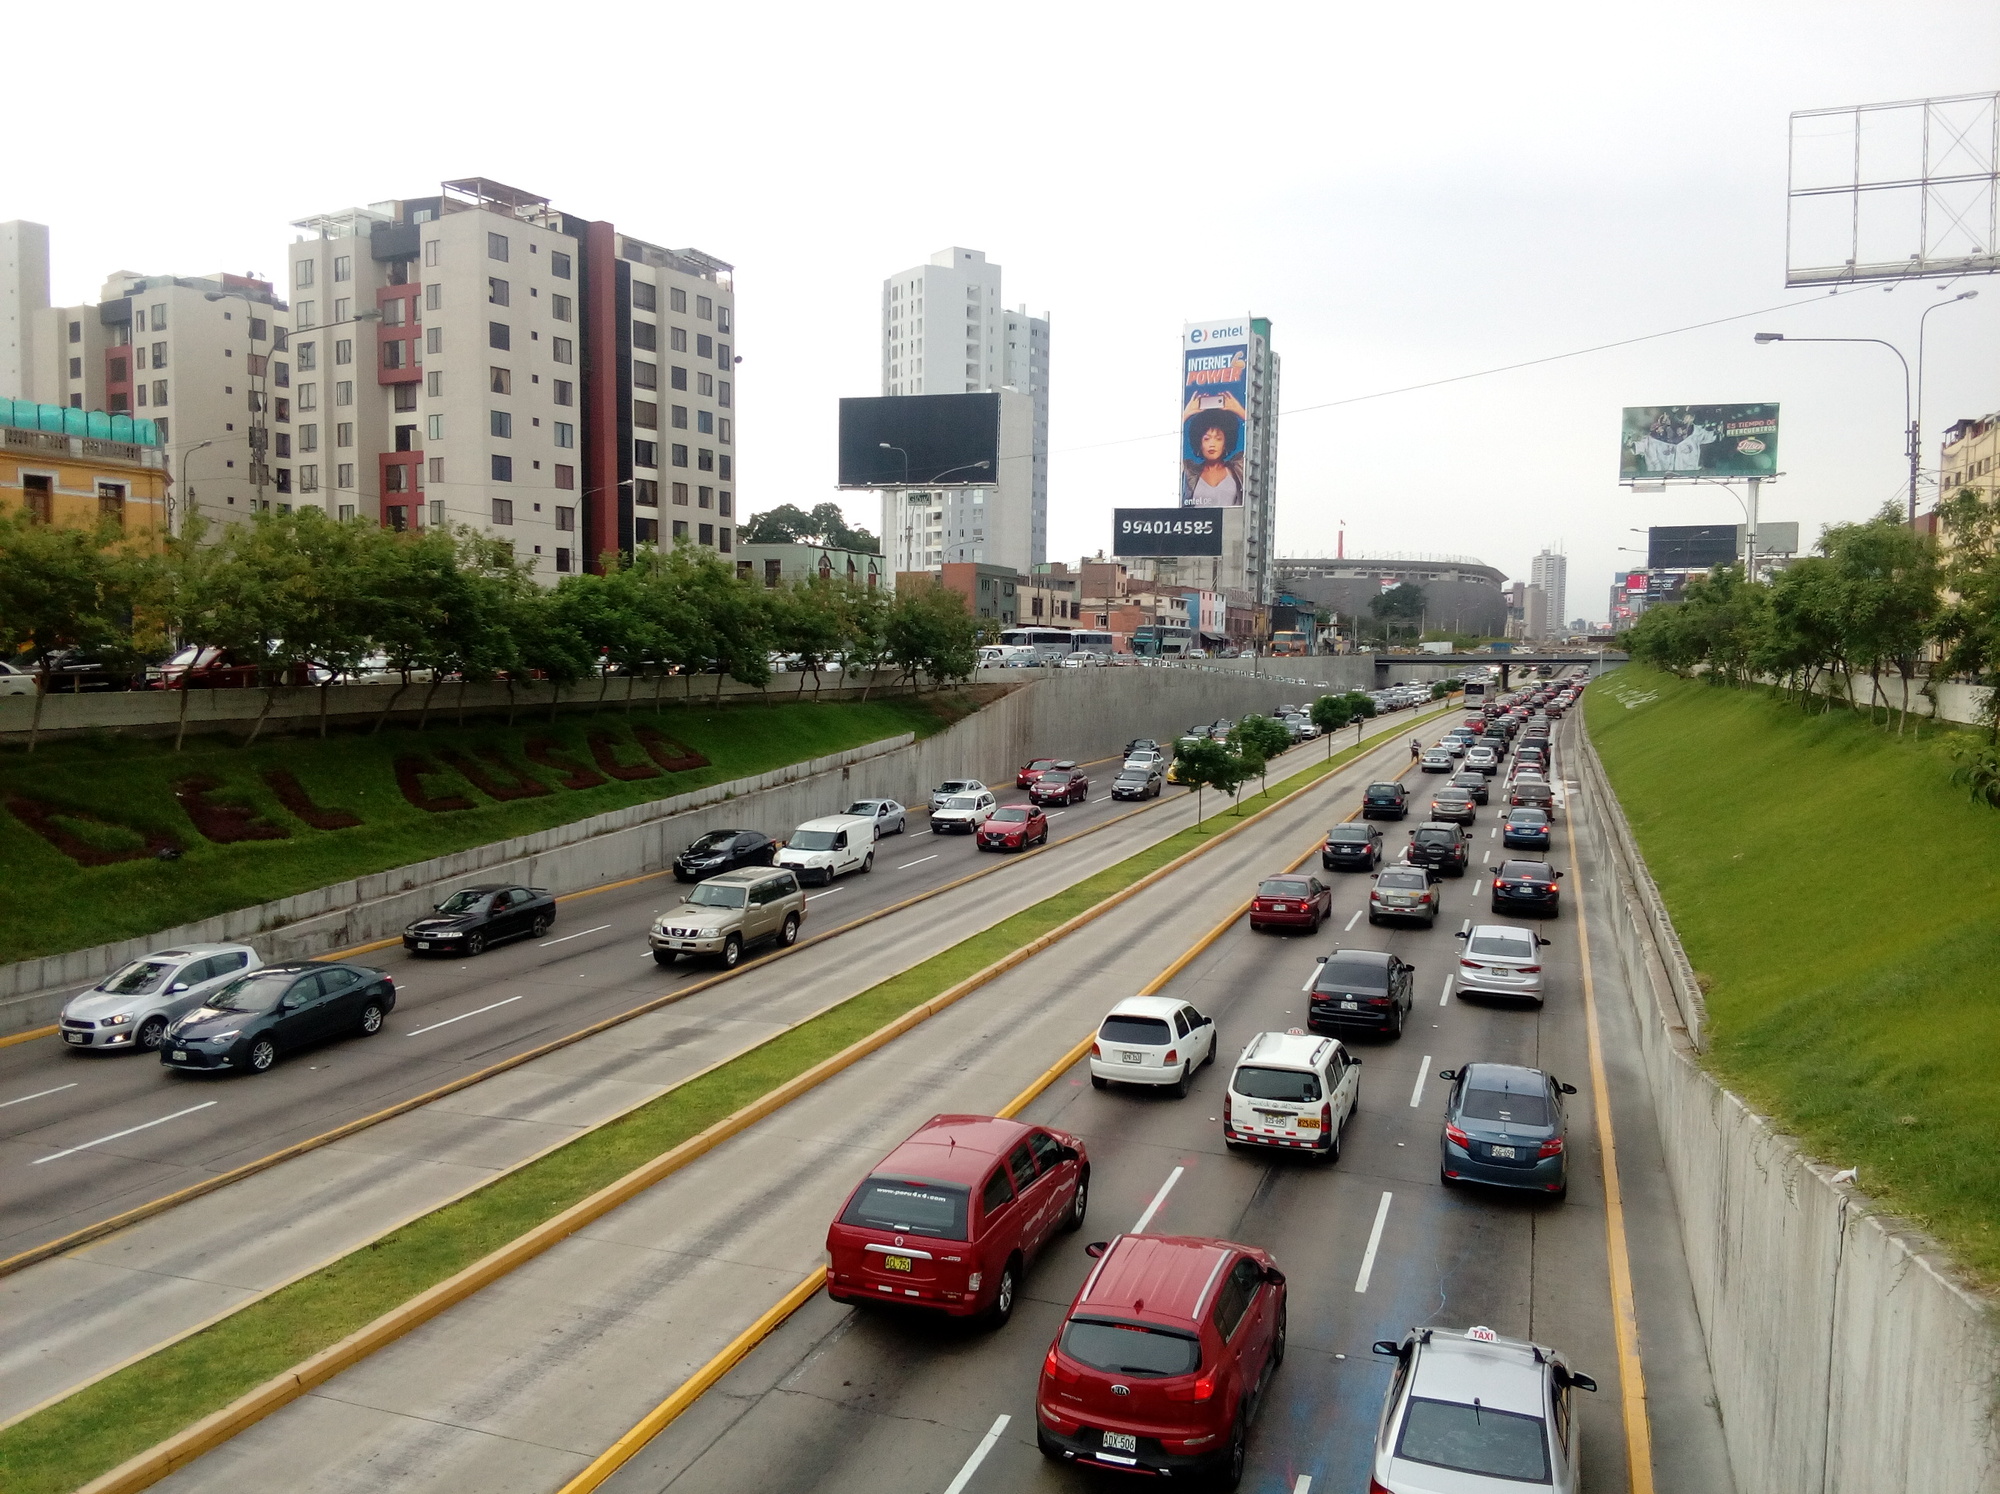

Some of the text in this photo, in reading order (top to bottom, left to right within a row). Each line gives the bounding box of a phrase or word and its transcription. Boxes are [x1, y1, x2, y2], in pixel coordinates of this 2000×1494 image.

[1212, 325, 1243, 339] entel
[1188, 354, 1233, 372] INTERNET
[1186, 366, 1243, 386] POWER
[1738, 420, 1765, 428] TIEMPO
[1122, 520, 1213, 535] 994014585
[393, 724, 713, 814] CUSCO
[876, 1186, 946, 1202] www.peru4x4.com
[1472, 1330, 1494, 1341] TAXI
[1112, 1386, 1128, 1396] KIA
[1103, 1433, 1135, 1451] ADX-506
